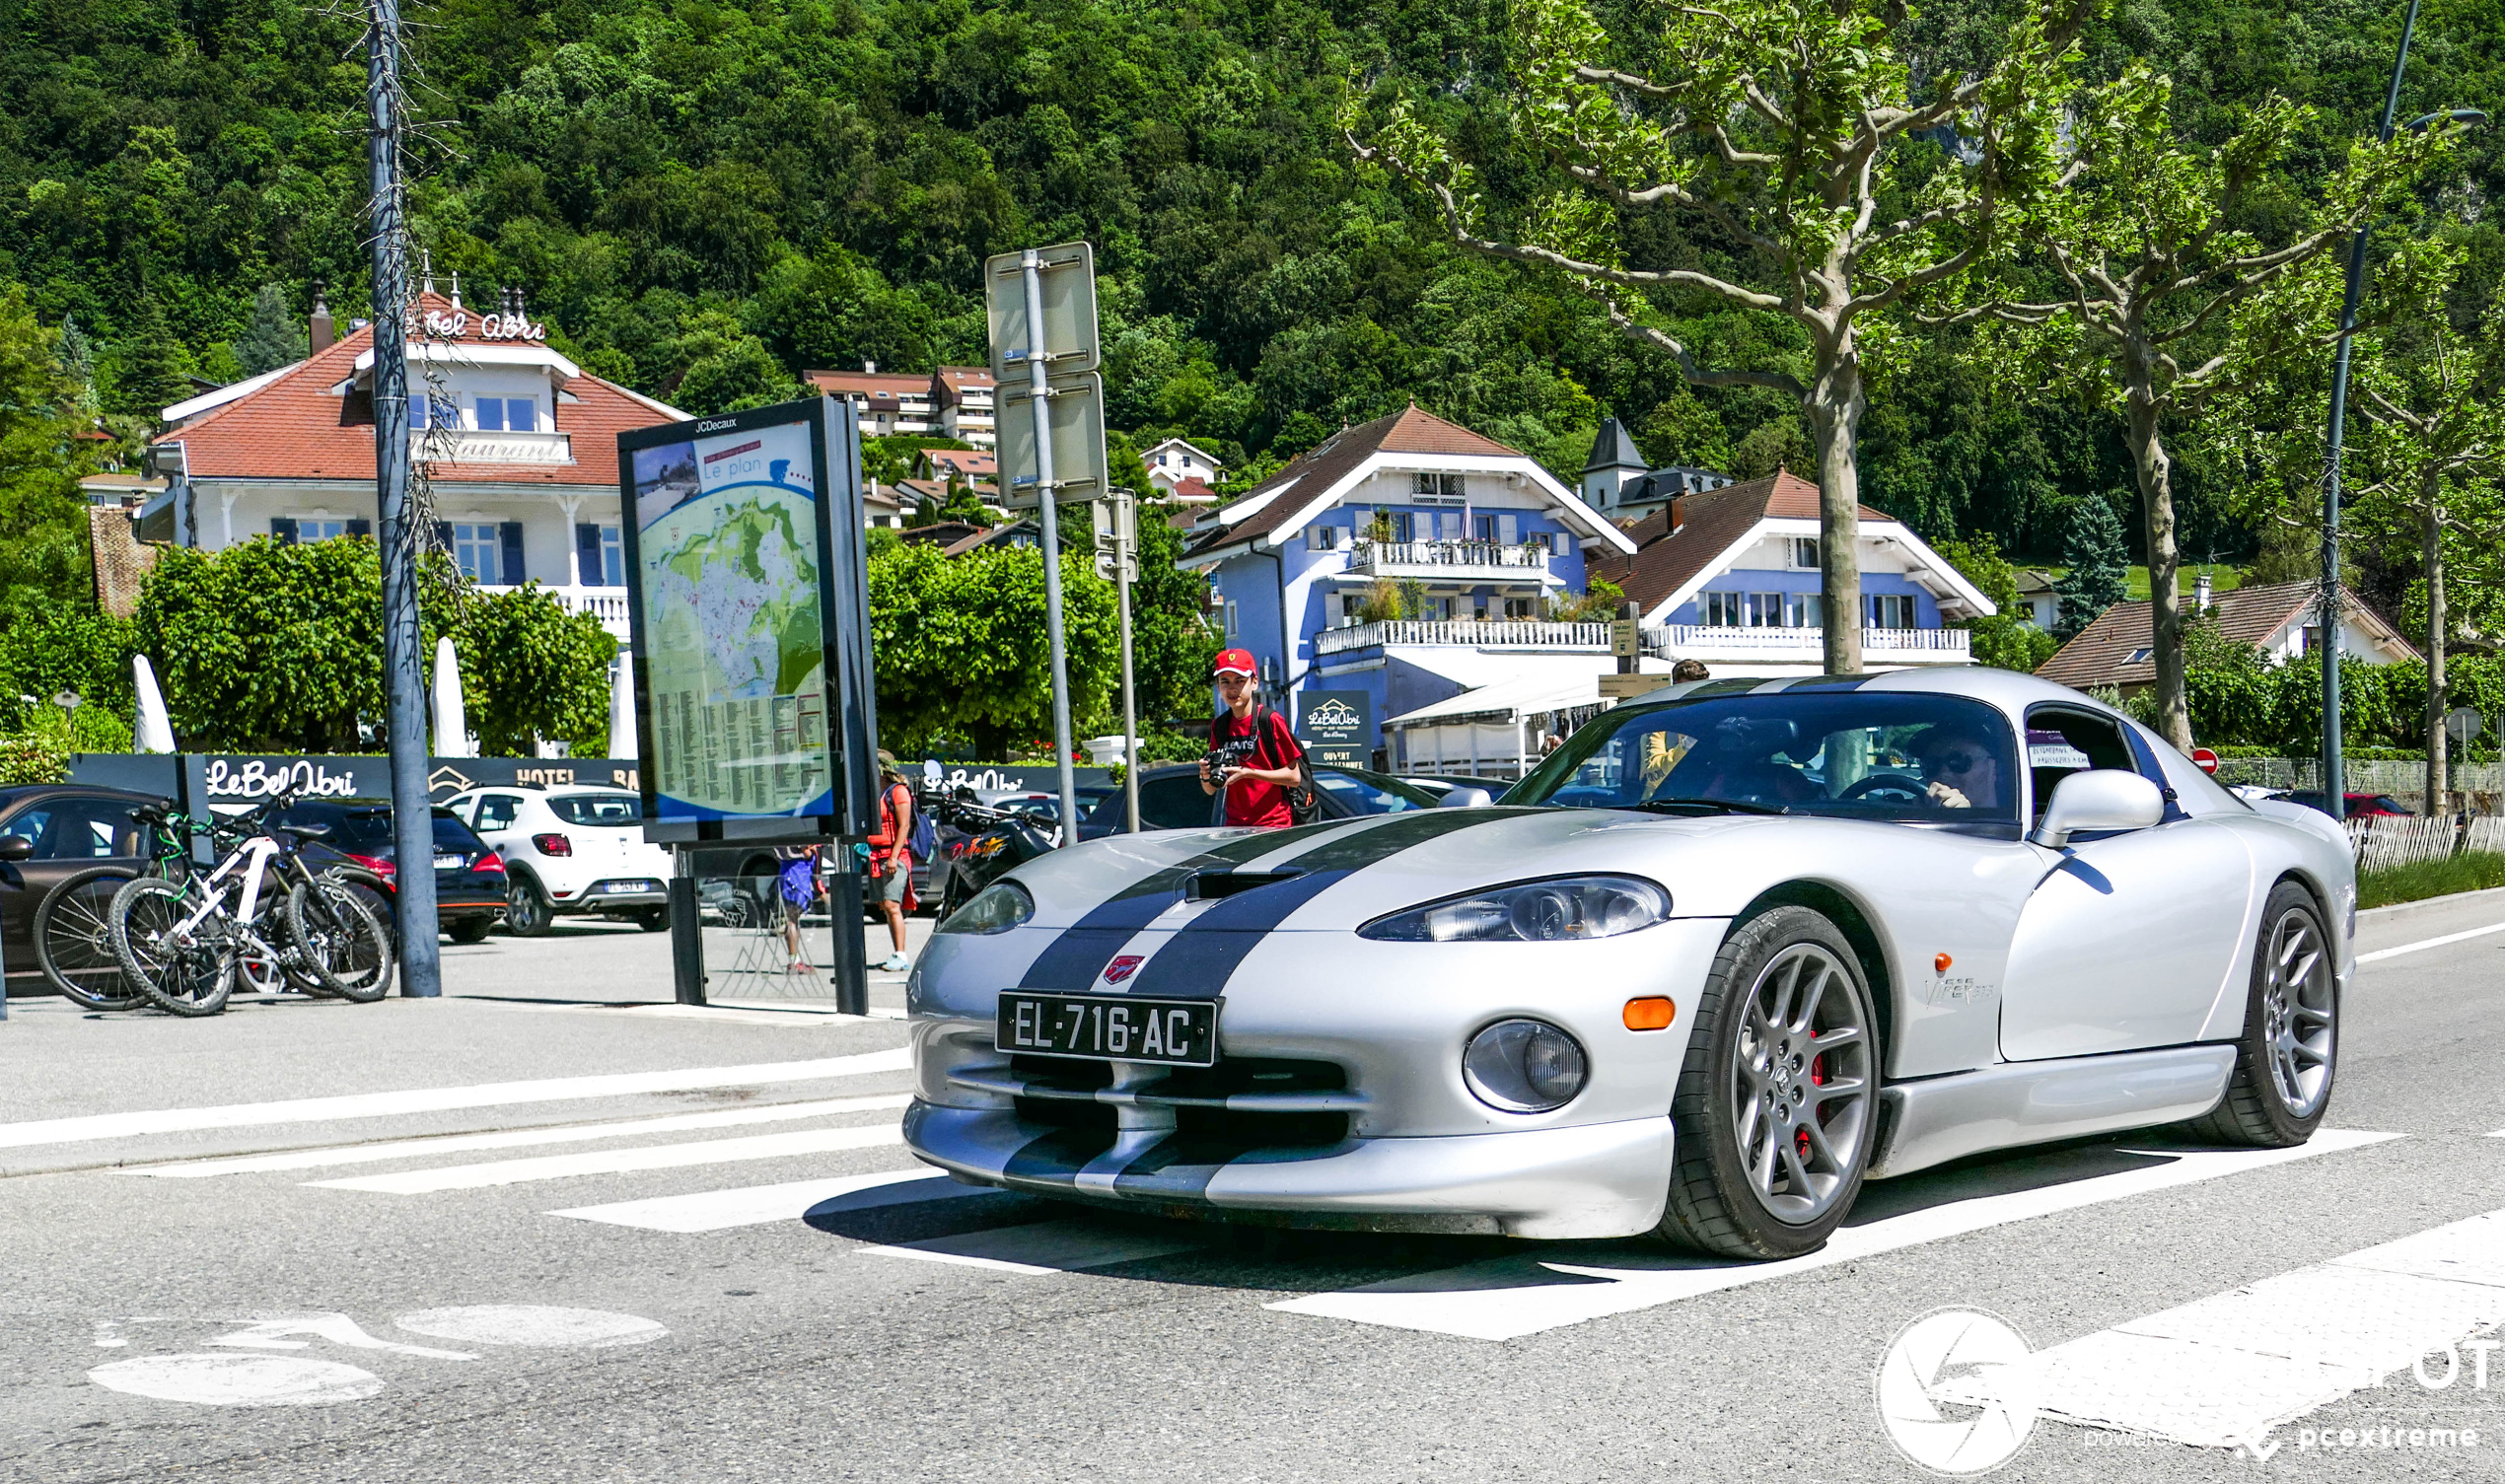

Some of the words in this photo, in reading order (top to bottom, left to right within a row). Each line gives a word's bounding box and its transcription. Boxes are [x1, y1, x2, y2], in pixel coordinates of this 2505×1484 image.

[481, 313, 545, 340] Abri
[695, 417, 738, 434] JCDecaux
[704, 462, 721, 479] Le
[729, 458, 761, 479] plan
